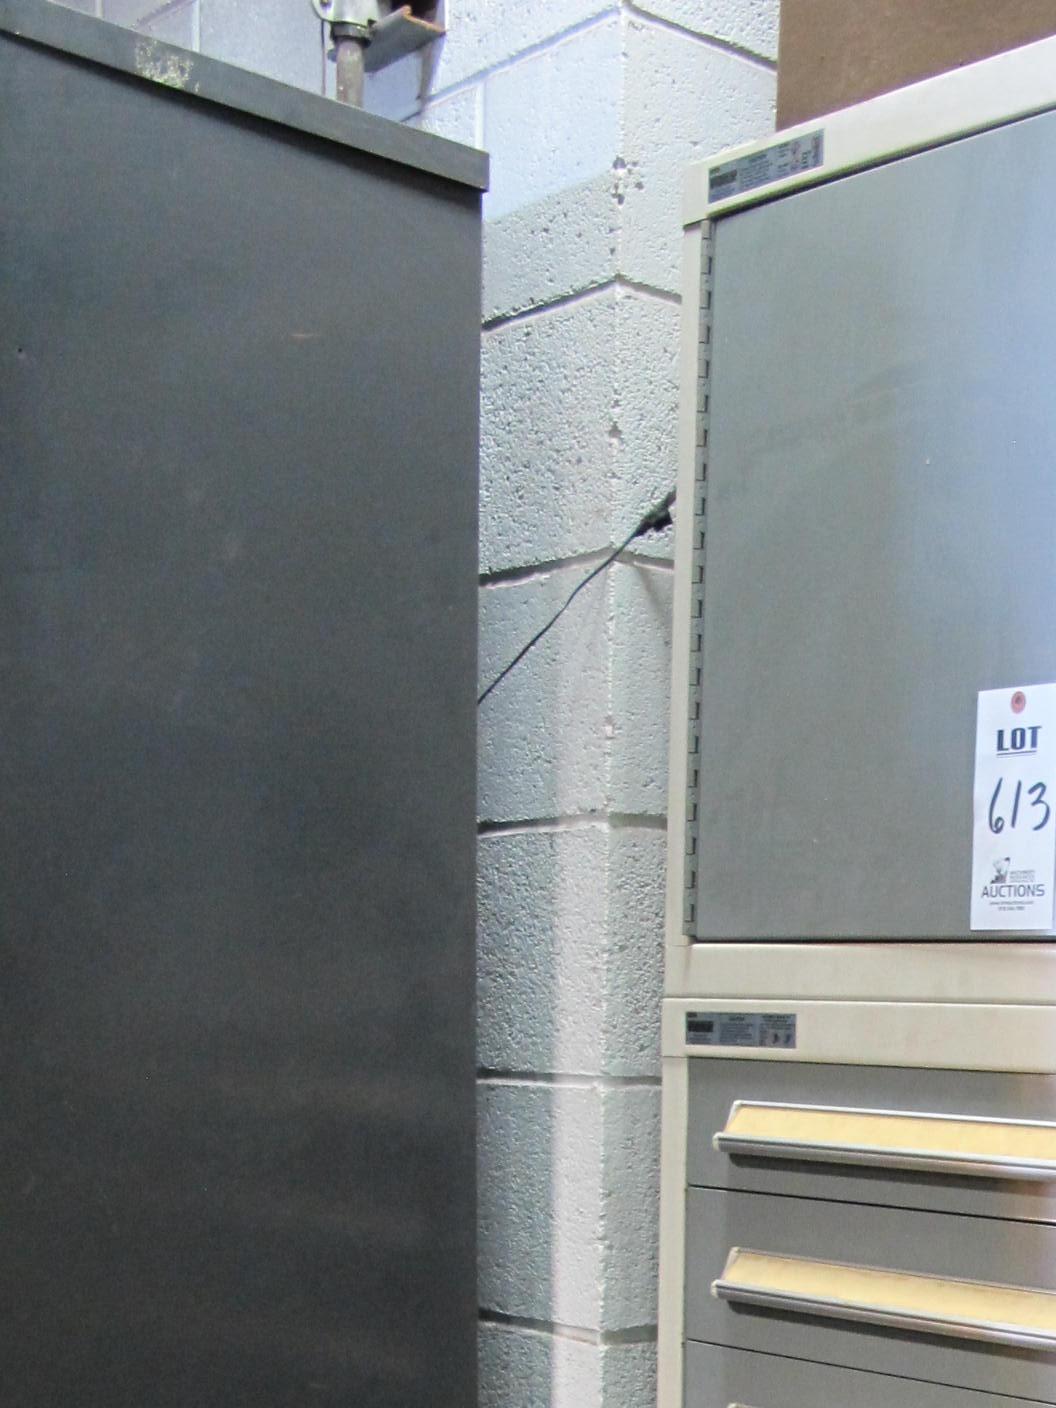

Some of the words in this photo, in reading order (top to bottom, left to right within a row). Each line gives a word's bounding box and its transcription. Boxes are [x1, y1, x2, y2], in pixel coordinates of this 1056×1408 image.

[996, 725, 1042, 752] LOT
[988, 776, 1051, 835] 613
[980, 883, 1046, 898] AUCTIONS
